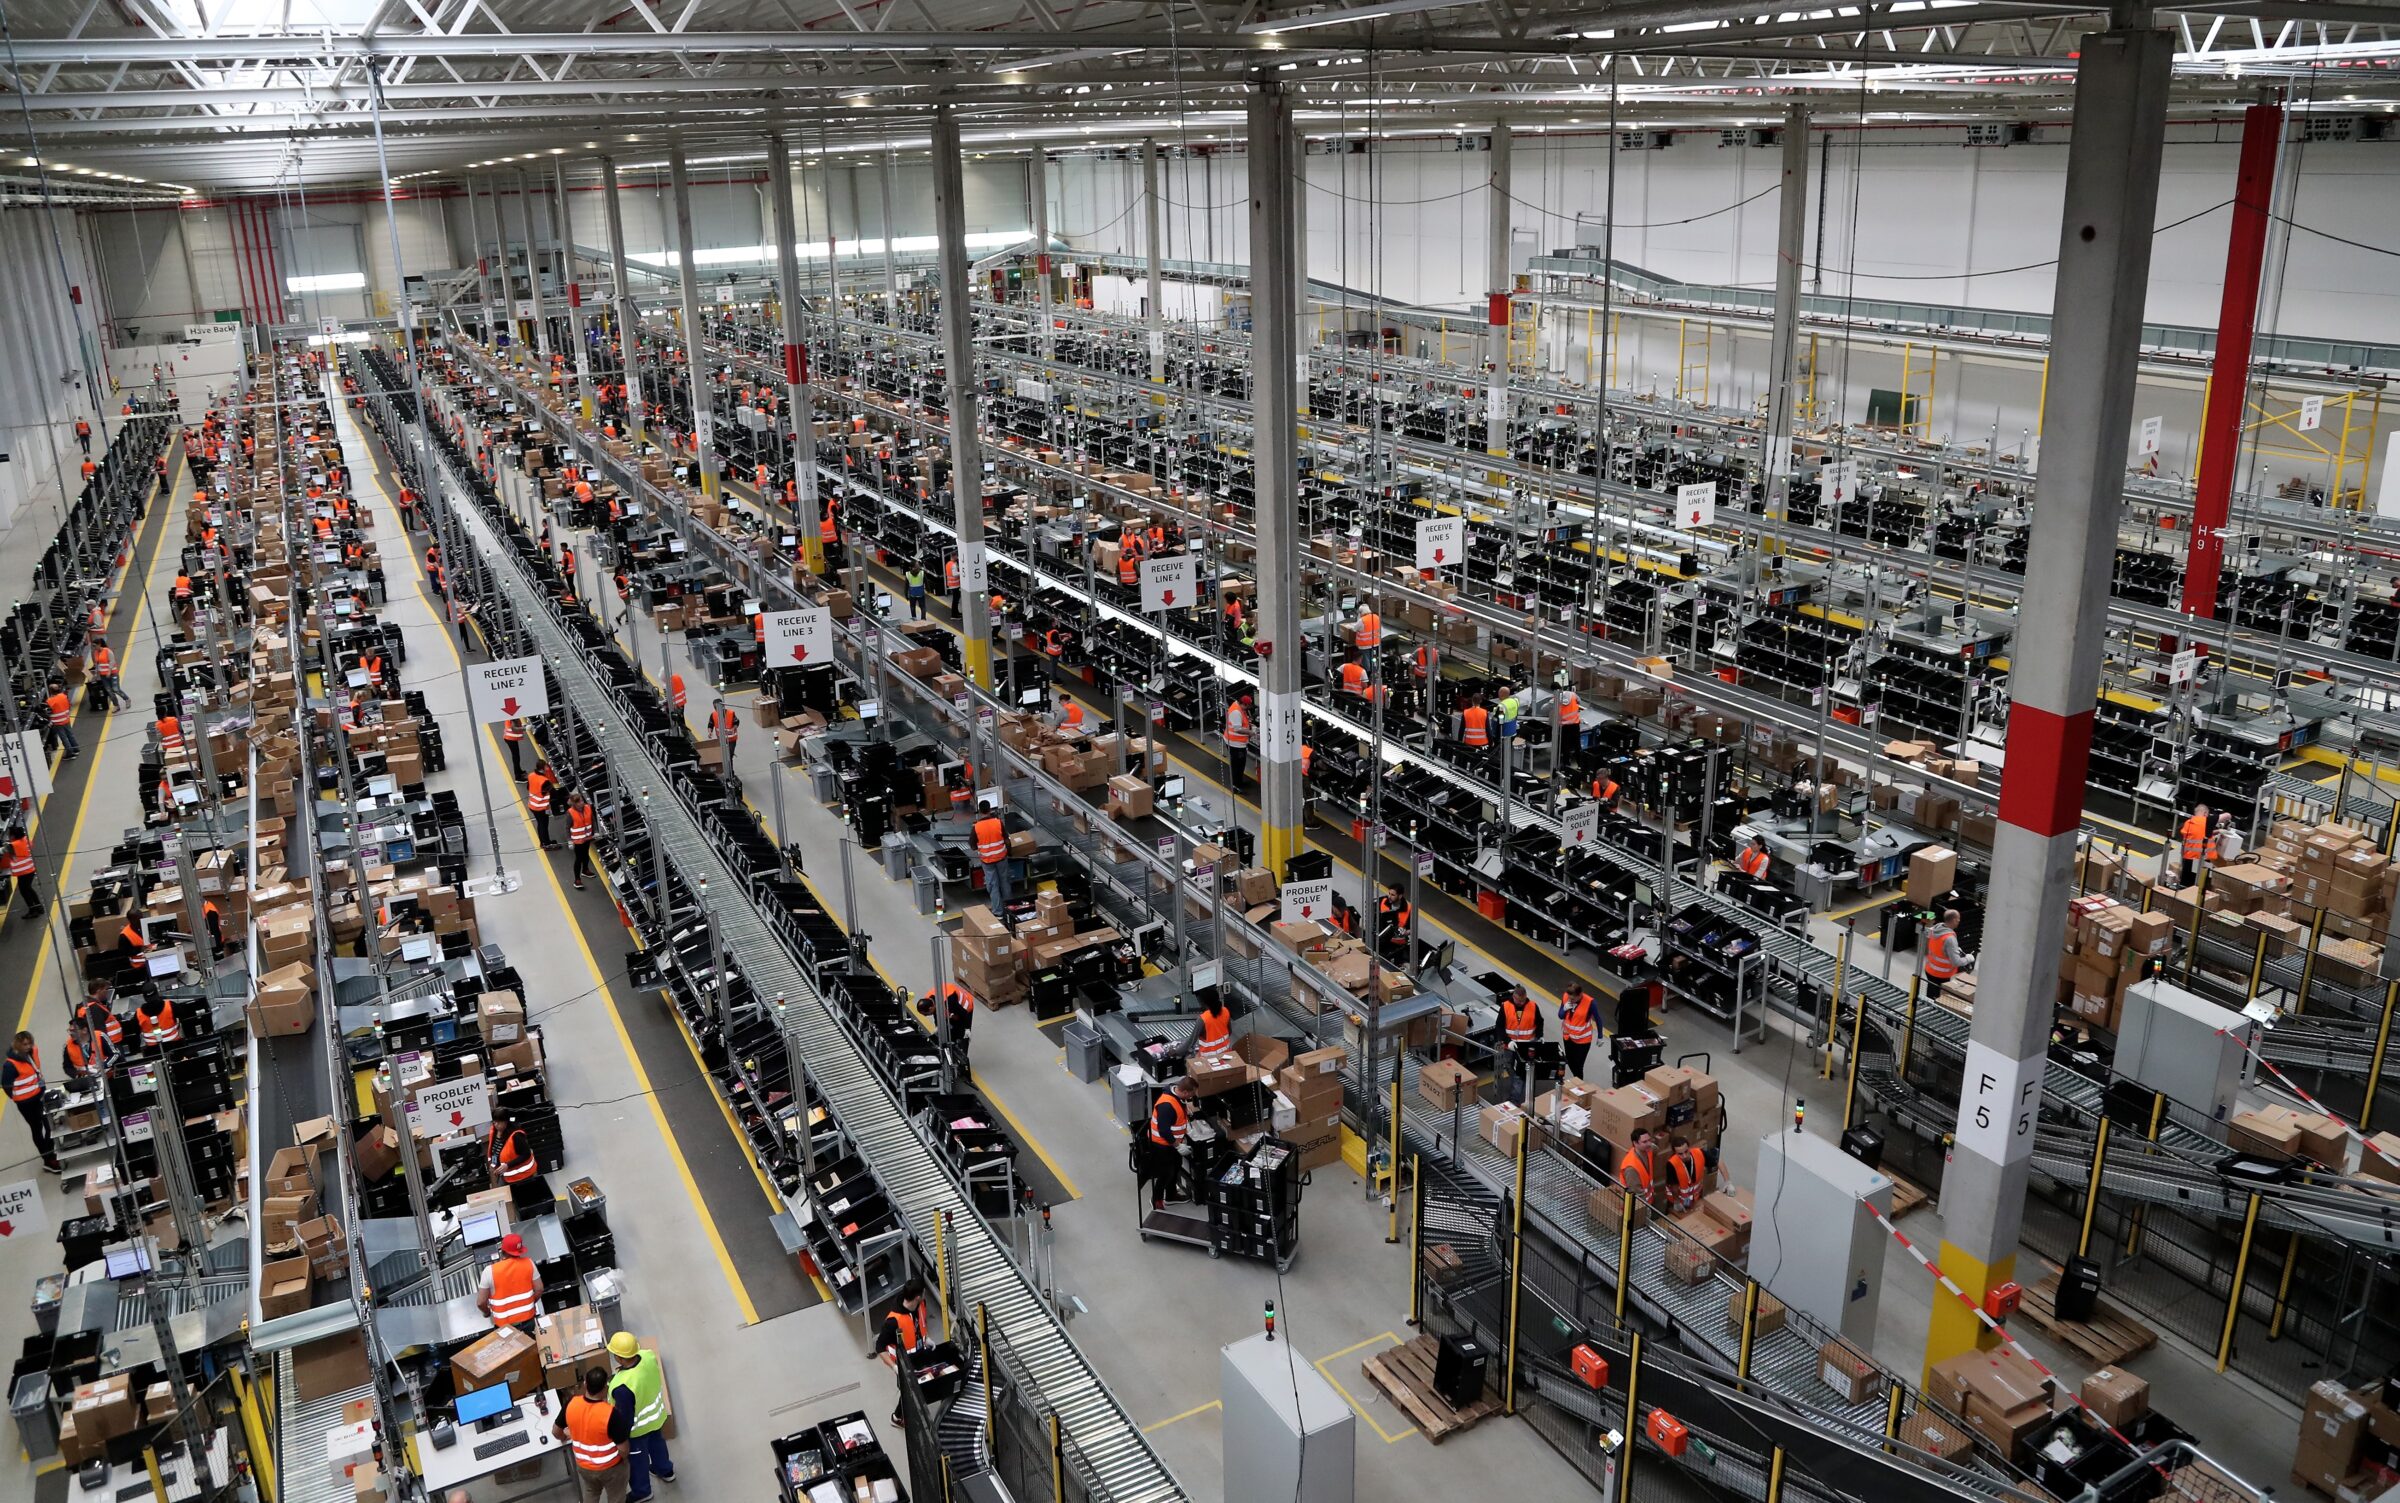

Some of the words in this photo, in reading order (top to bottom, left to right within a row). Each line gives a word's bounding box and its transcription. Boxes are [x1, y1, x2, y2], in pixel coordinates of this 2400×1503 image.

[190, 327, 212, 335] Have
[807, 482, 812, 491] 5
[1686, 487, 1710, 496] RECEIVE
[1688, 498, 1701, 506] LINE
[1426, 523, 1452, 533] RECEIVE
[2198, 524, 2208, 536] H
[1428, 534, 1444, 542] LINE
[2197, 539, 2205, 550] 9
[974, 553, 980, 565] J
[1151, 562, 1184, 573] RECEIVE
[974, 568, 981, 580] 5
[1156, 574, 1172, 583] LINE
[777, 615, 817, 627] RECEIVE
[783, 628, 804, 638] LINE
[807, 626, 814, 635] 3
[2174, 654, 2193, 663] PROBLEM
[484, 664, 528, 678] RECEIVE
[2176, 662, 2188, 670] SOLVE
[491, 680, 515, 690] LINE
[518, 678, 524, 687] 2
[1284, 709, 1296, 726] H
[1286, 730, 1295, 744] 5
[0, 741, 22, 752] VE
[12, 756, 18, 764] 1
[1566, 809, 1596, 822] PROBLEM
[1570, 818, 1590, 830] SOLVE
[360, 832, 372, 840] 2-27
[1286, 884, 1328, 896] PROBLEM
[1292, 894, 1320, 905] SOLVE
[402, 1066, 418, 1074] 2-29
[136, 1078, 150, 1086] 1-2
[1980, 1073, 1996, 1094] F
[423, 1082, 480, 1104] PROBLEM
[2021, 1080, 2036, 1106] F
[434, 1096, 474, 1112] SOLVE
[411, 1114, 422, 1122] 2-
[1976, 1105, 1990, 1128] 5
[2018, 1112, 2030, 1136] 5
[130, 1127, 148, 1136] 1-30
[0, 1203, 24, 1218] LVE
